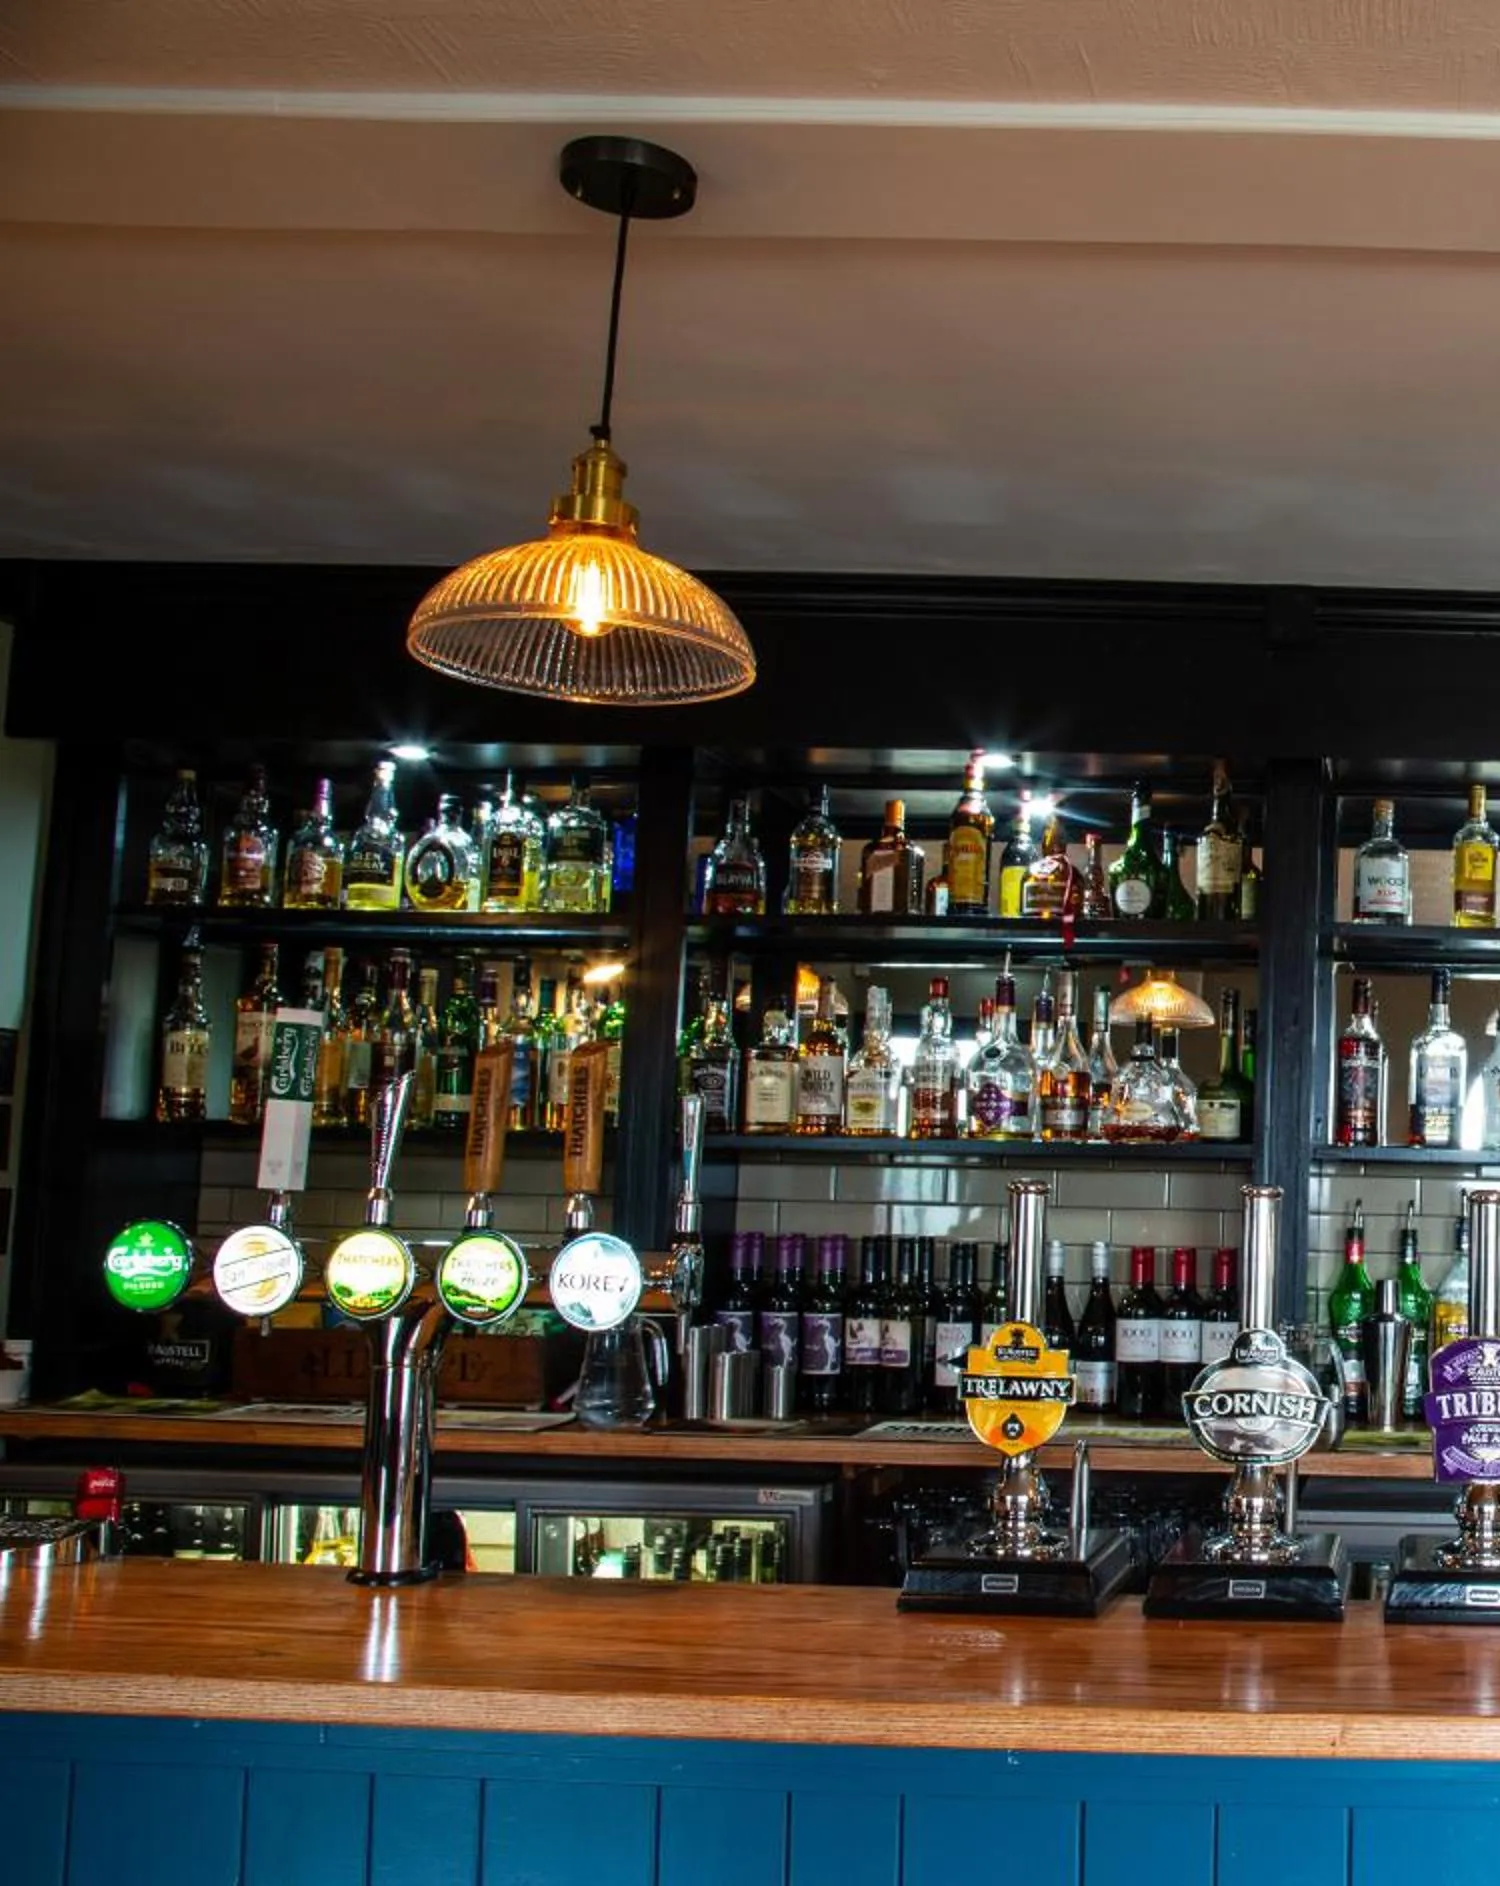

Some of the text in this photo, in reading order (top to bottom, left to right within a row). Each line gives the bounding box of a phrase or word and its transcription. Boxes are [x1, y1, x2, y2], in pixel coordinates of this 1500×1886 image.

[271, 1027, 299, 1095] Carlsberg
[469, 1067, 490, 1156] THATCHERS
[569, 1065, 589, 1157] THATCHERS
[107, 1246, 186, 1277] Carlsberg
[964, 1377, 1071, 1399] TRELAWNY
[1193, 1392, 1317, 1421] CORNISH
